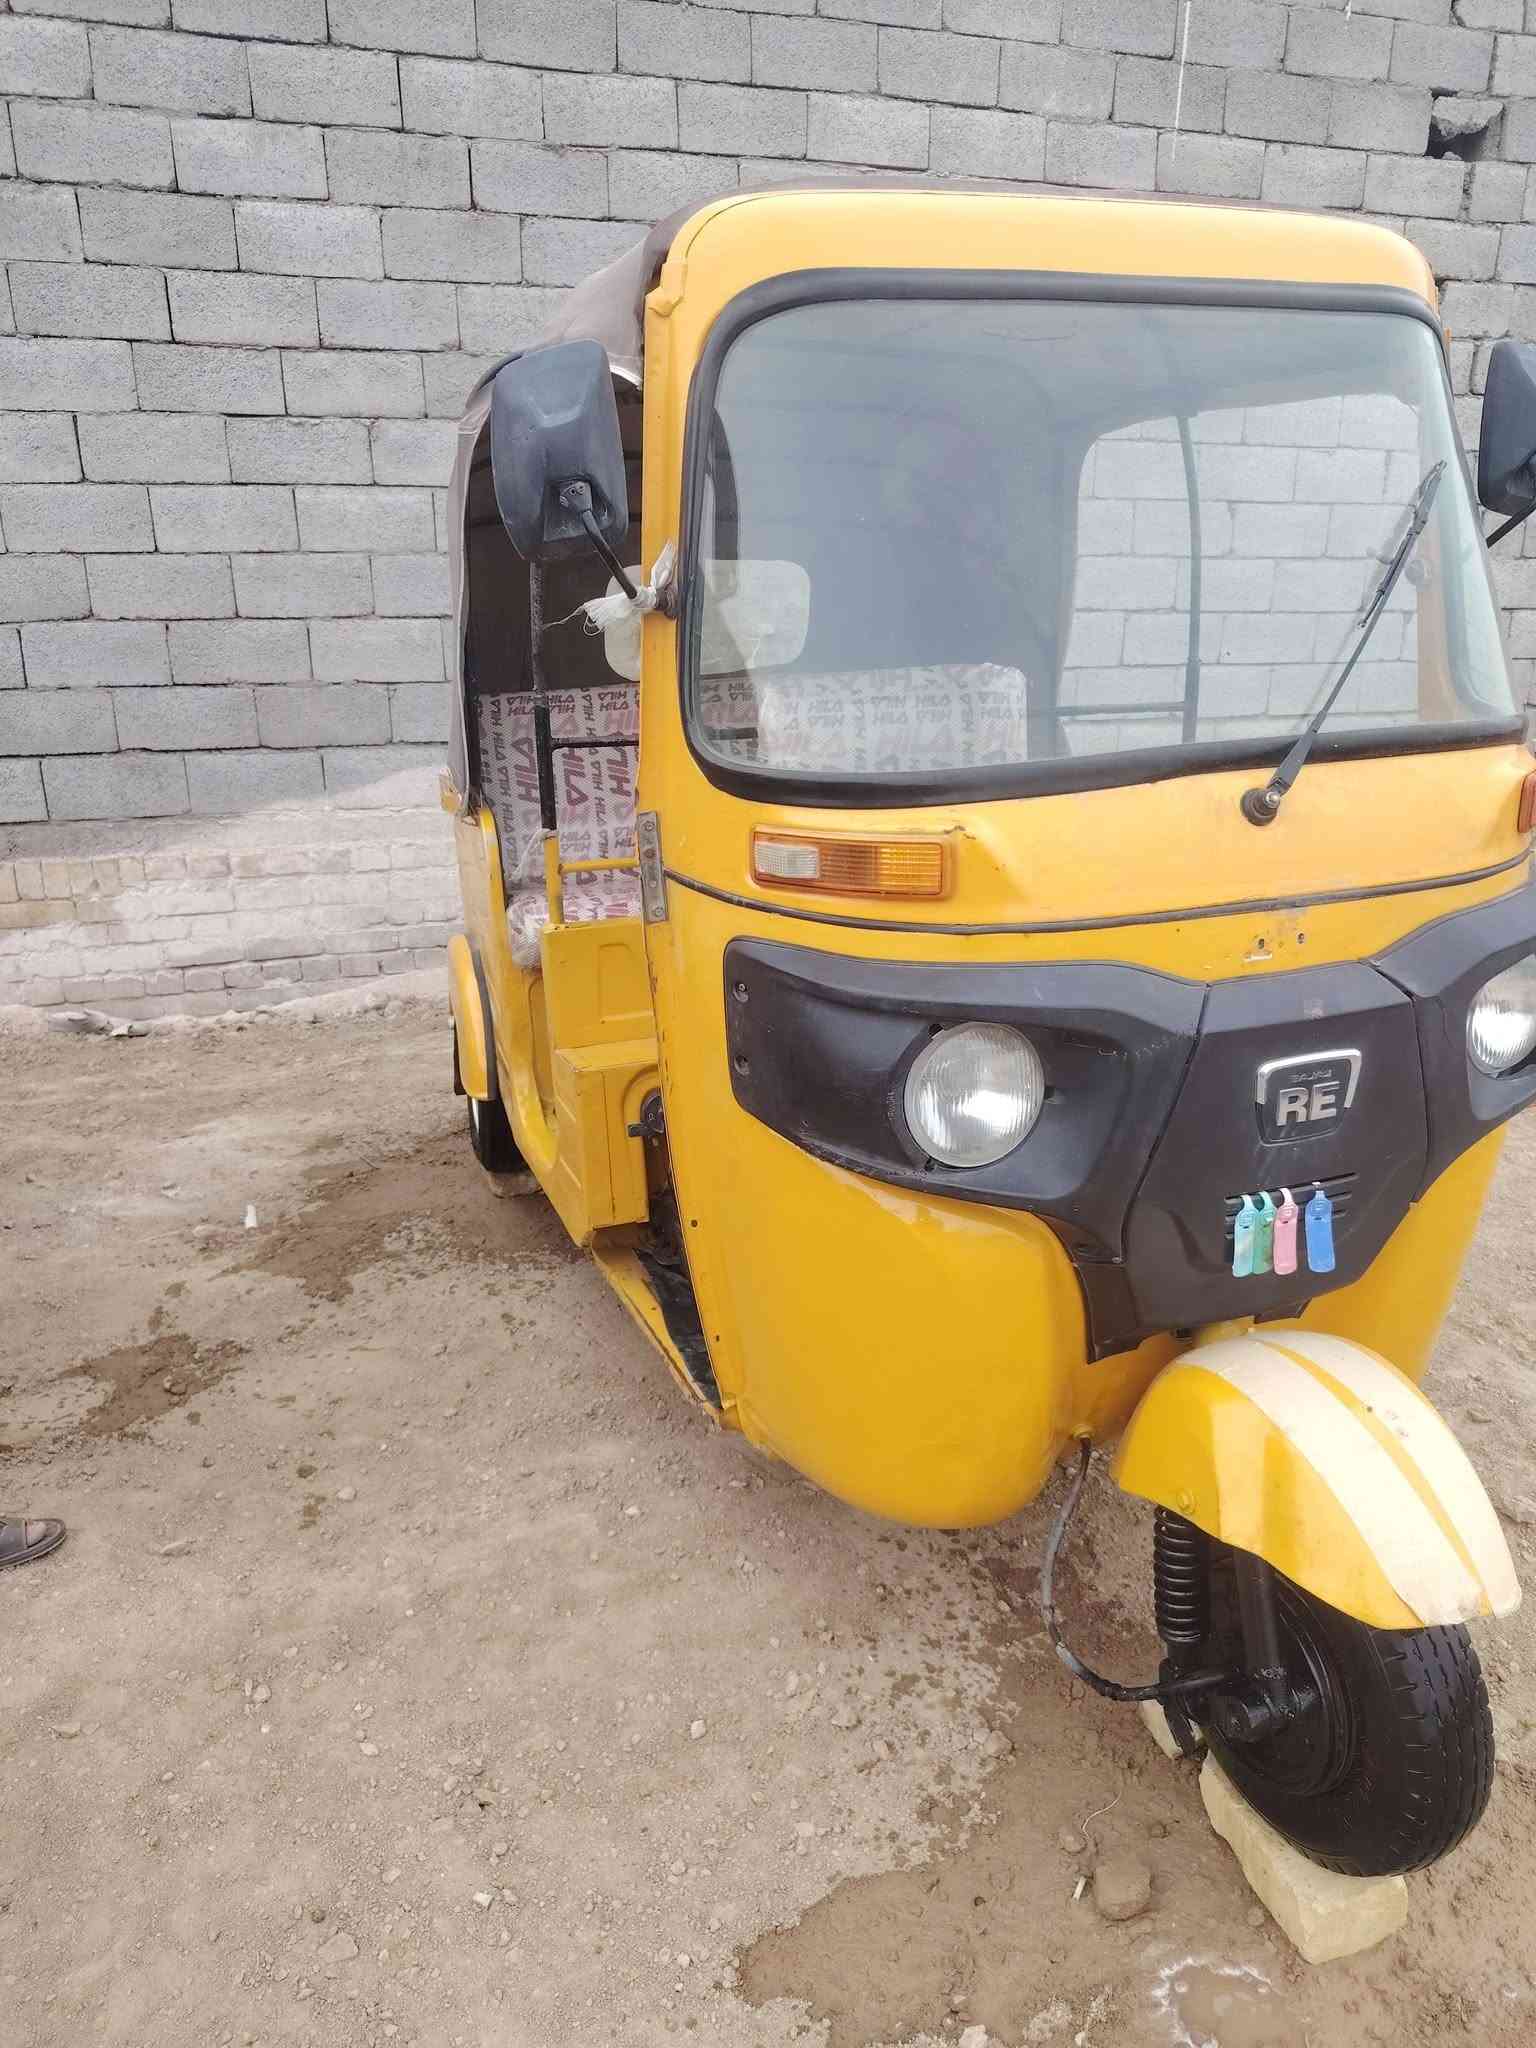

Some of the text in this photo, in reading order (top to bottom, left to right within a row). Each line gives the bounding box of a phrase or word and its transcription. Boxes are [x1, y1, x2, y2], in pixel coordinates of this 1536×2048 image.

[546, 694, 575, 704] HILA
[598, 690, 628, 702] HILA
[583, 694, 595, 721] HILA
[600, 701, 629, 712] HILA
[591, 760, 604, 791] HILA
[595, 796, 606, 827] HILA
[561, 831, 591, 841] HILA
[1276, 1082, 1339, 1126] RE
